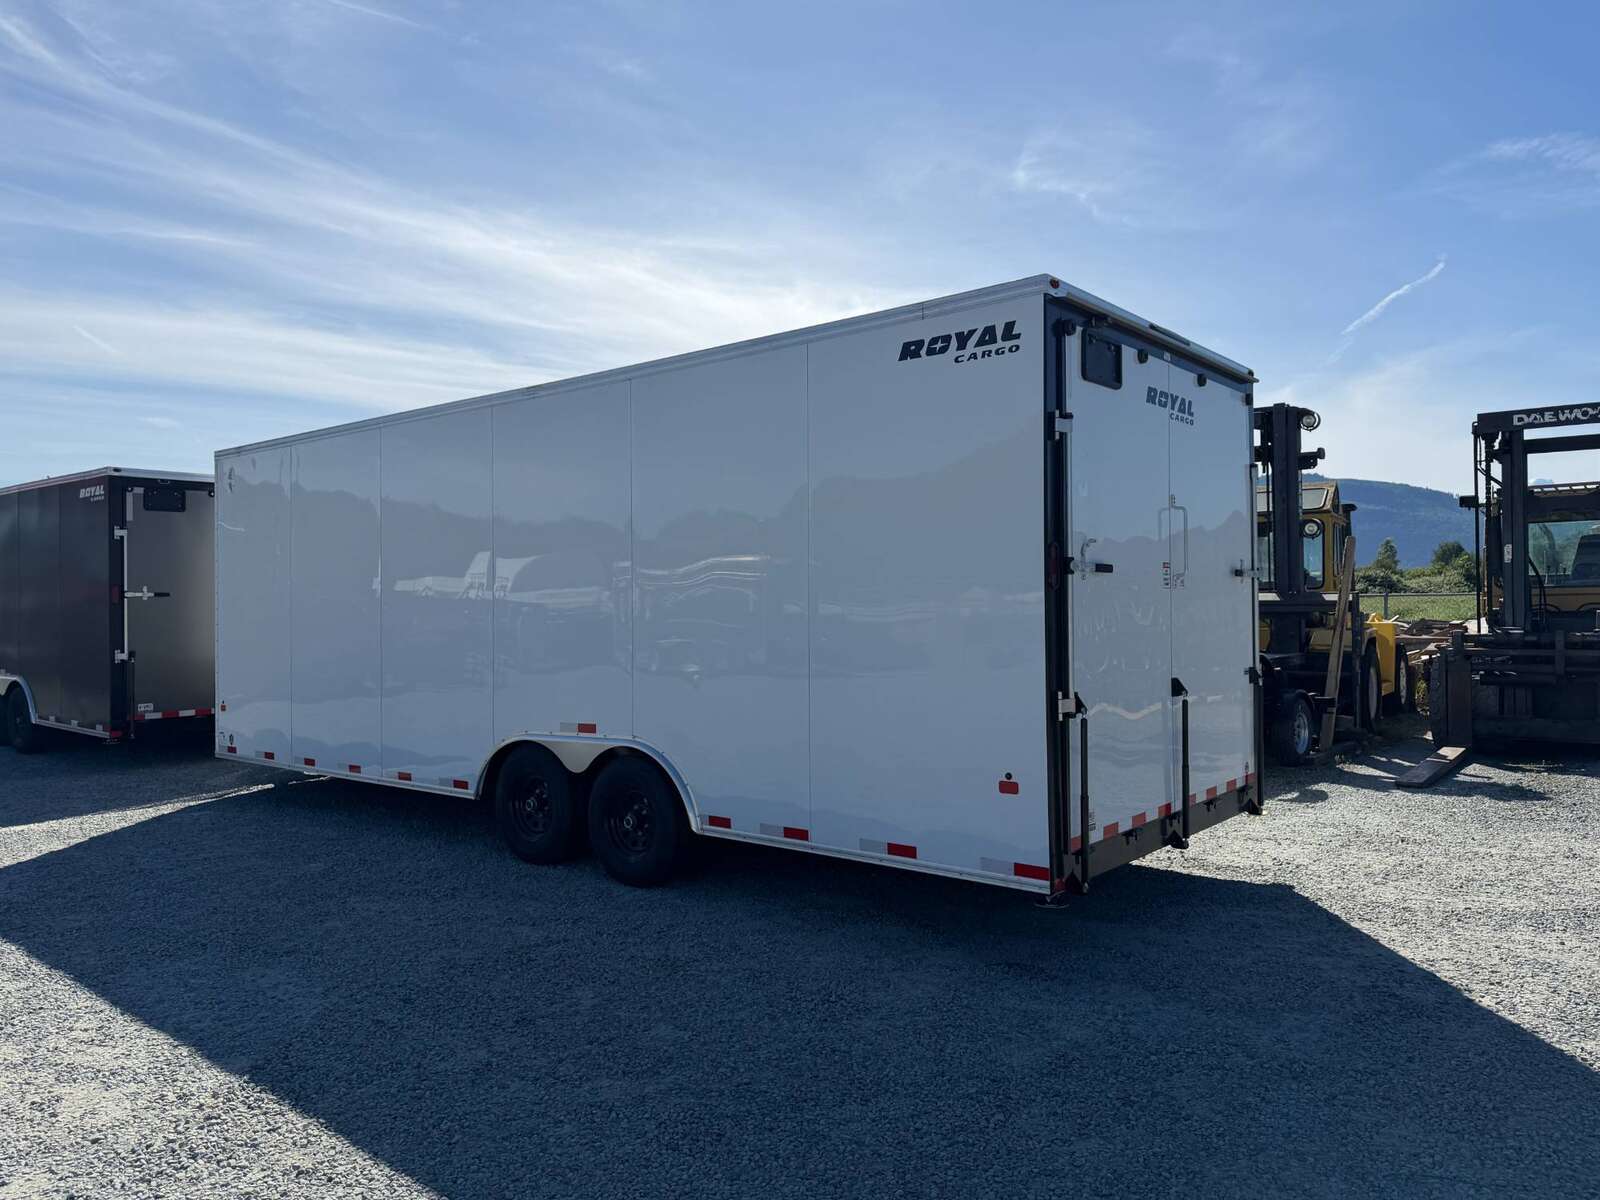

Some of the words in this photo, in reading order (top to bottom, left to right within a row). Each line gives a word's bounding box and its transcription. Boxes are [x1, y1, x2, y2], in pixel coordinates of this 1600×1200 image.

[898, 320, 1021, 361] ROYAL
[954, 344, 1020, 363] CARGO
[1146, 386, 1194, 417] ROYAL
[1512, 406, 1600, 425] DAEWO
[80, 485, 104, 498] ROYAL
